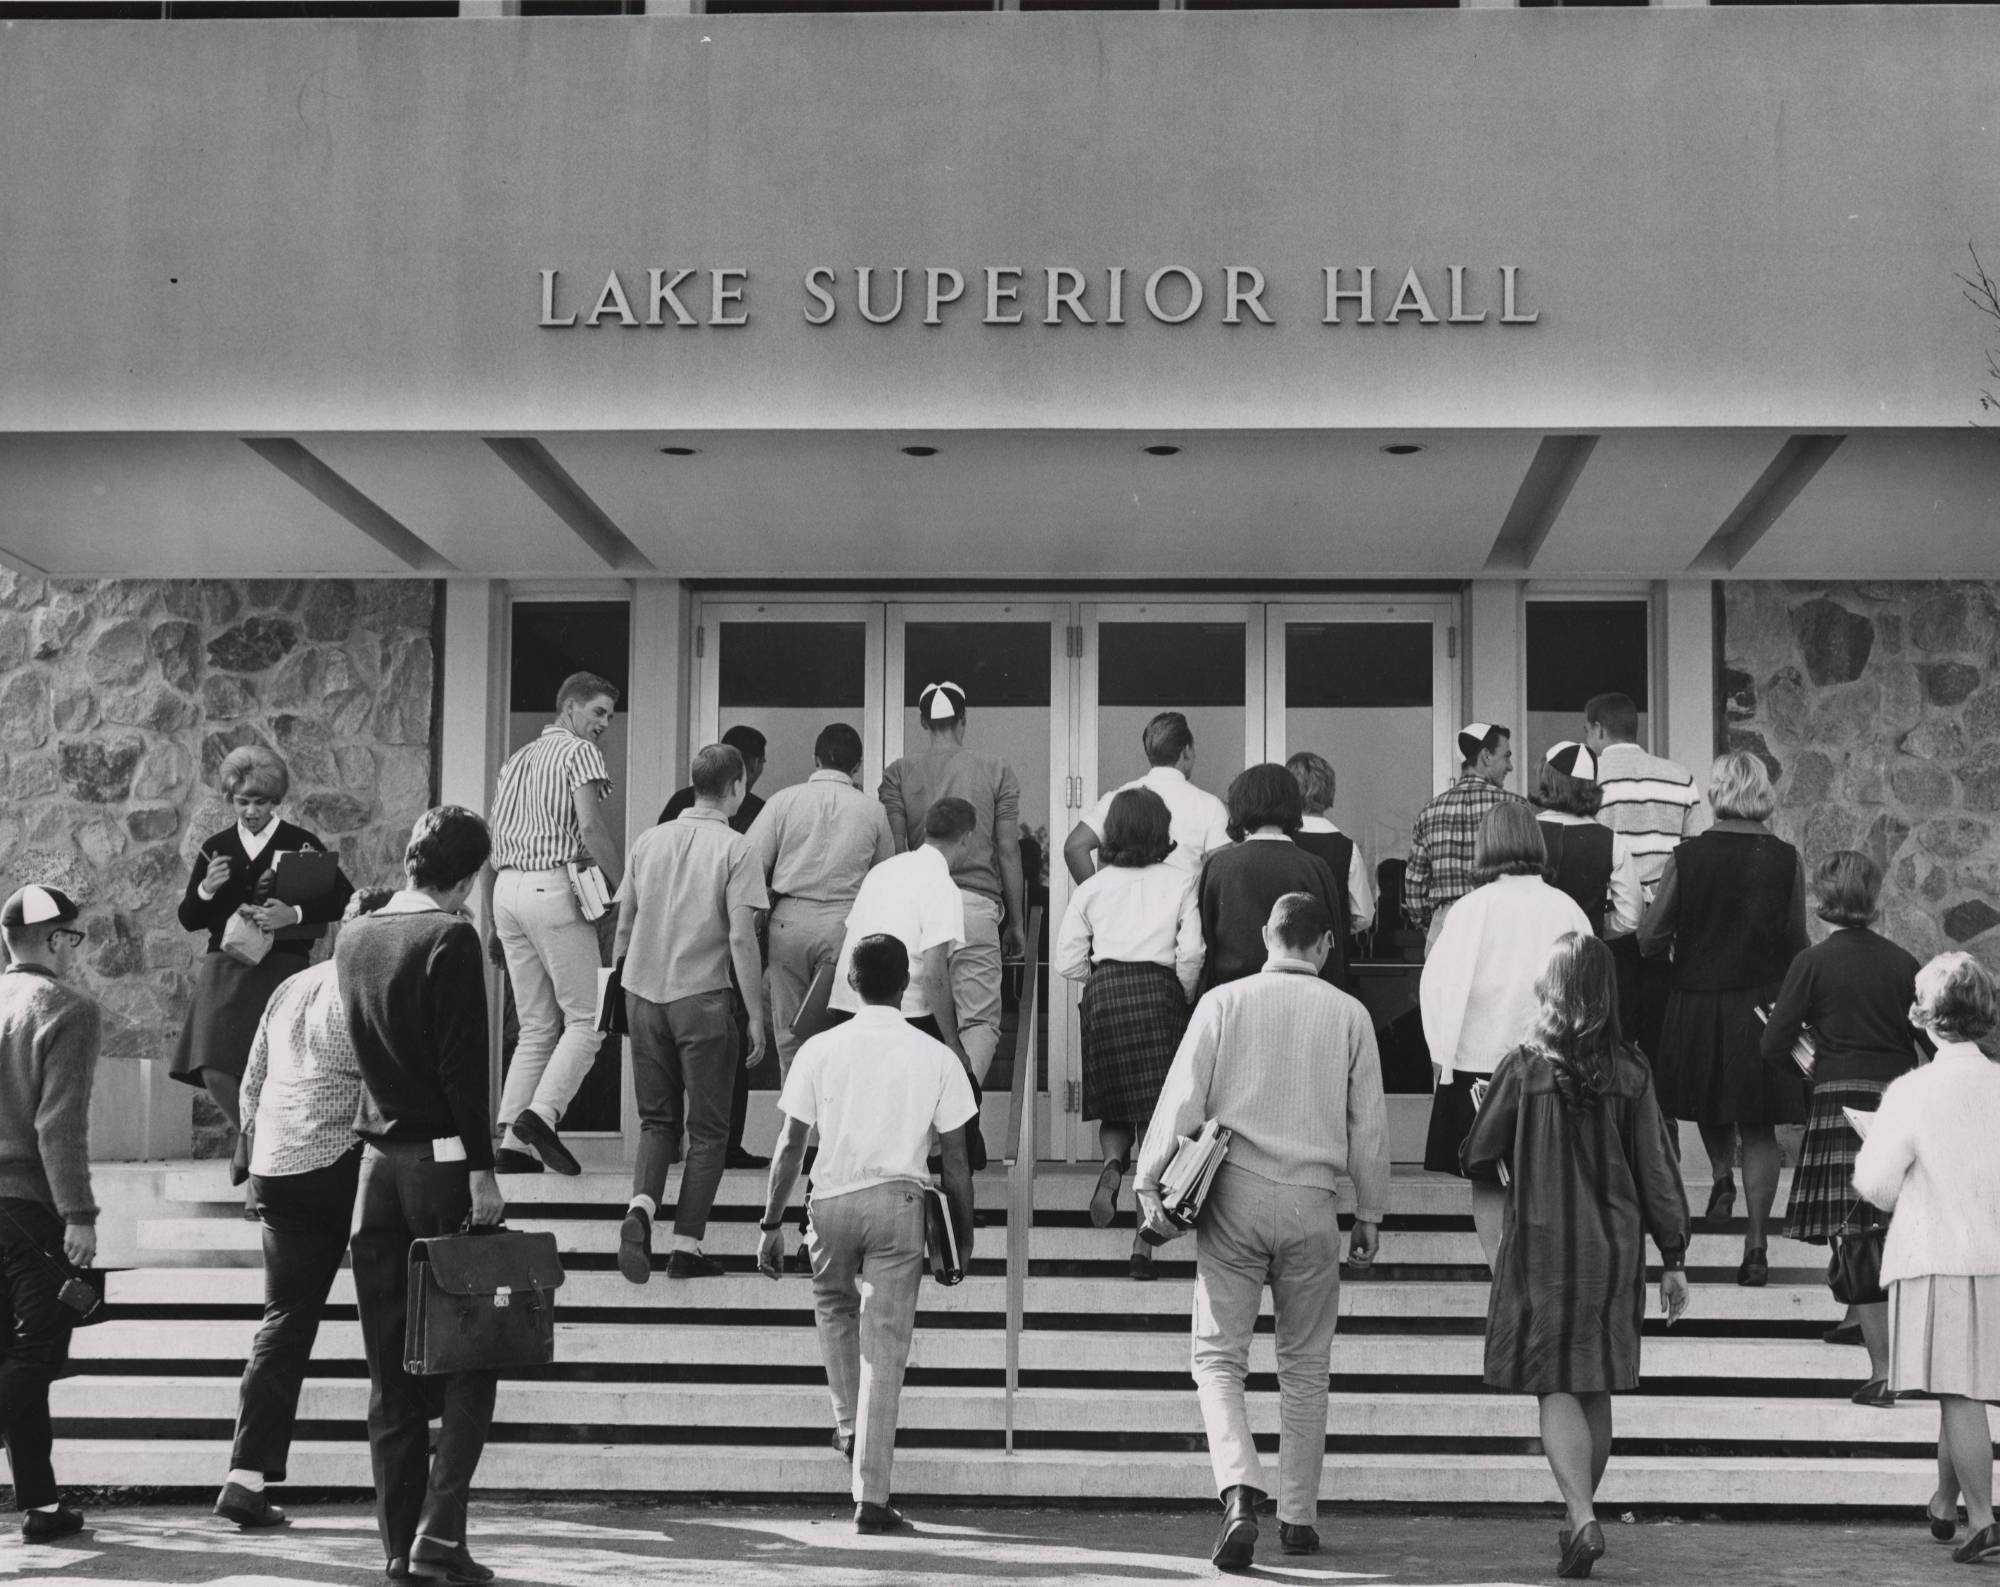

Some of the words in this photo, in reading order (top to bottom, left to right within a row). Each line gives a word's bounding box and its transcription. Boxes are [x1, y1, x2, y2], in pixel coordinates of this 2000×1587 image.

[538, 268, 750, 327] LAKE
[803, 264, 1277, 325] SUPERIOR
[1321, 265, 1541, 324] HALL
